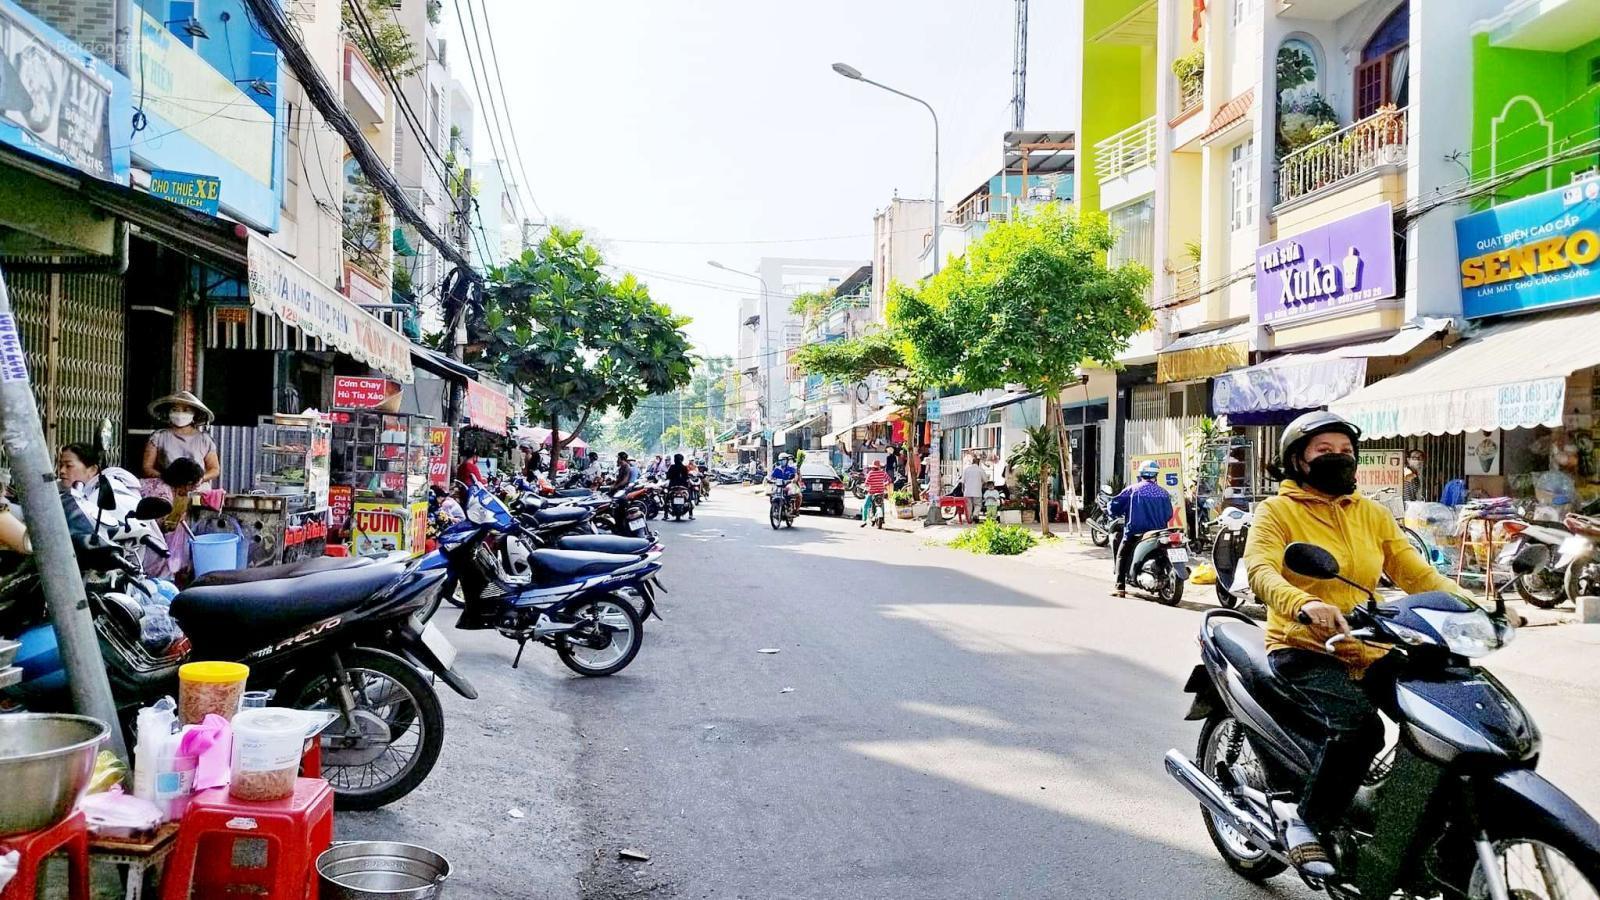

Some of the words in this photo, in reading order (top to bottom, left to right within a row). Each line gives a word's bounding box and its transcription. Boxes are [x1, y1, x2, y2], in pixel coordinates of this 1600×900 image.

[152, 179, 169, 194] CHO
[171, 180, 194, 197] THUÊ
[196, 179, 219, 200] XE
[1477, 235, 1504, 251] QUẠT
[1530, 223, 1554, 237] CAO
[1555, 213, 1580, 230] CẤP
[1260, 247, 1281, 271] TRÀ
[1461, 229, 1600, 288] SENKO
[1280, 258, 1338, 306] Xuka
[338, 379, 358, 388] Cơm
[360, 380, 381, 390] Chay
[356, 506, 399, 533] CƠM
